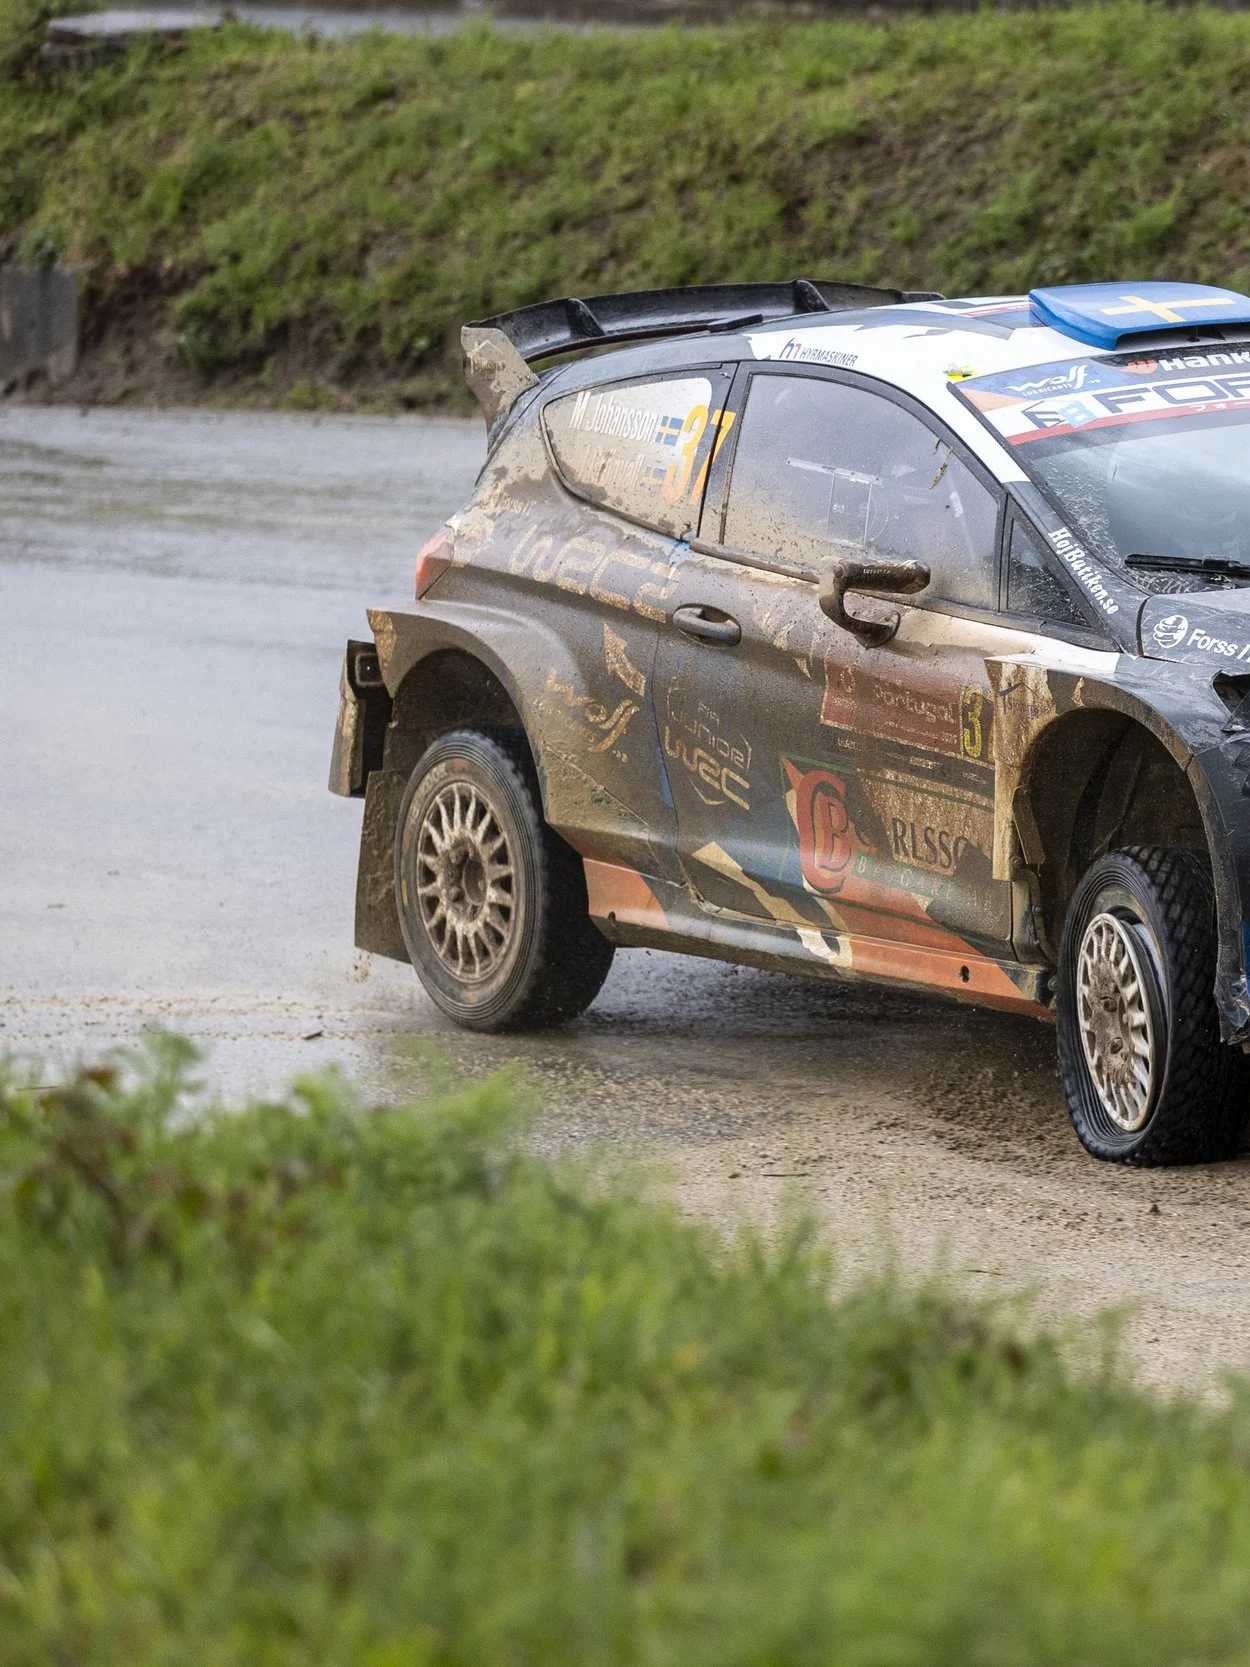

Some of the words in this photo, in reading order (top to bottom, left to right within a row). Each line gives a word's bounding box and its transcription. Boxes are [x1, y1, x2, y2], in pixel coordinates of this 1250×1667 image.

[800, 348, 858, 367] HYRMASKINER
[1021, 382, 1073, 398] LUBRICANTS
[586, 393, 660, 445] Johansson
[662, 404, 737, 507] 37
[1187, 628, 1237, 658] Forss
[665, 726, 751, 811] WRC
